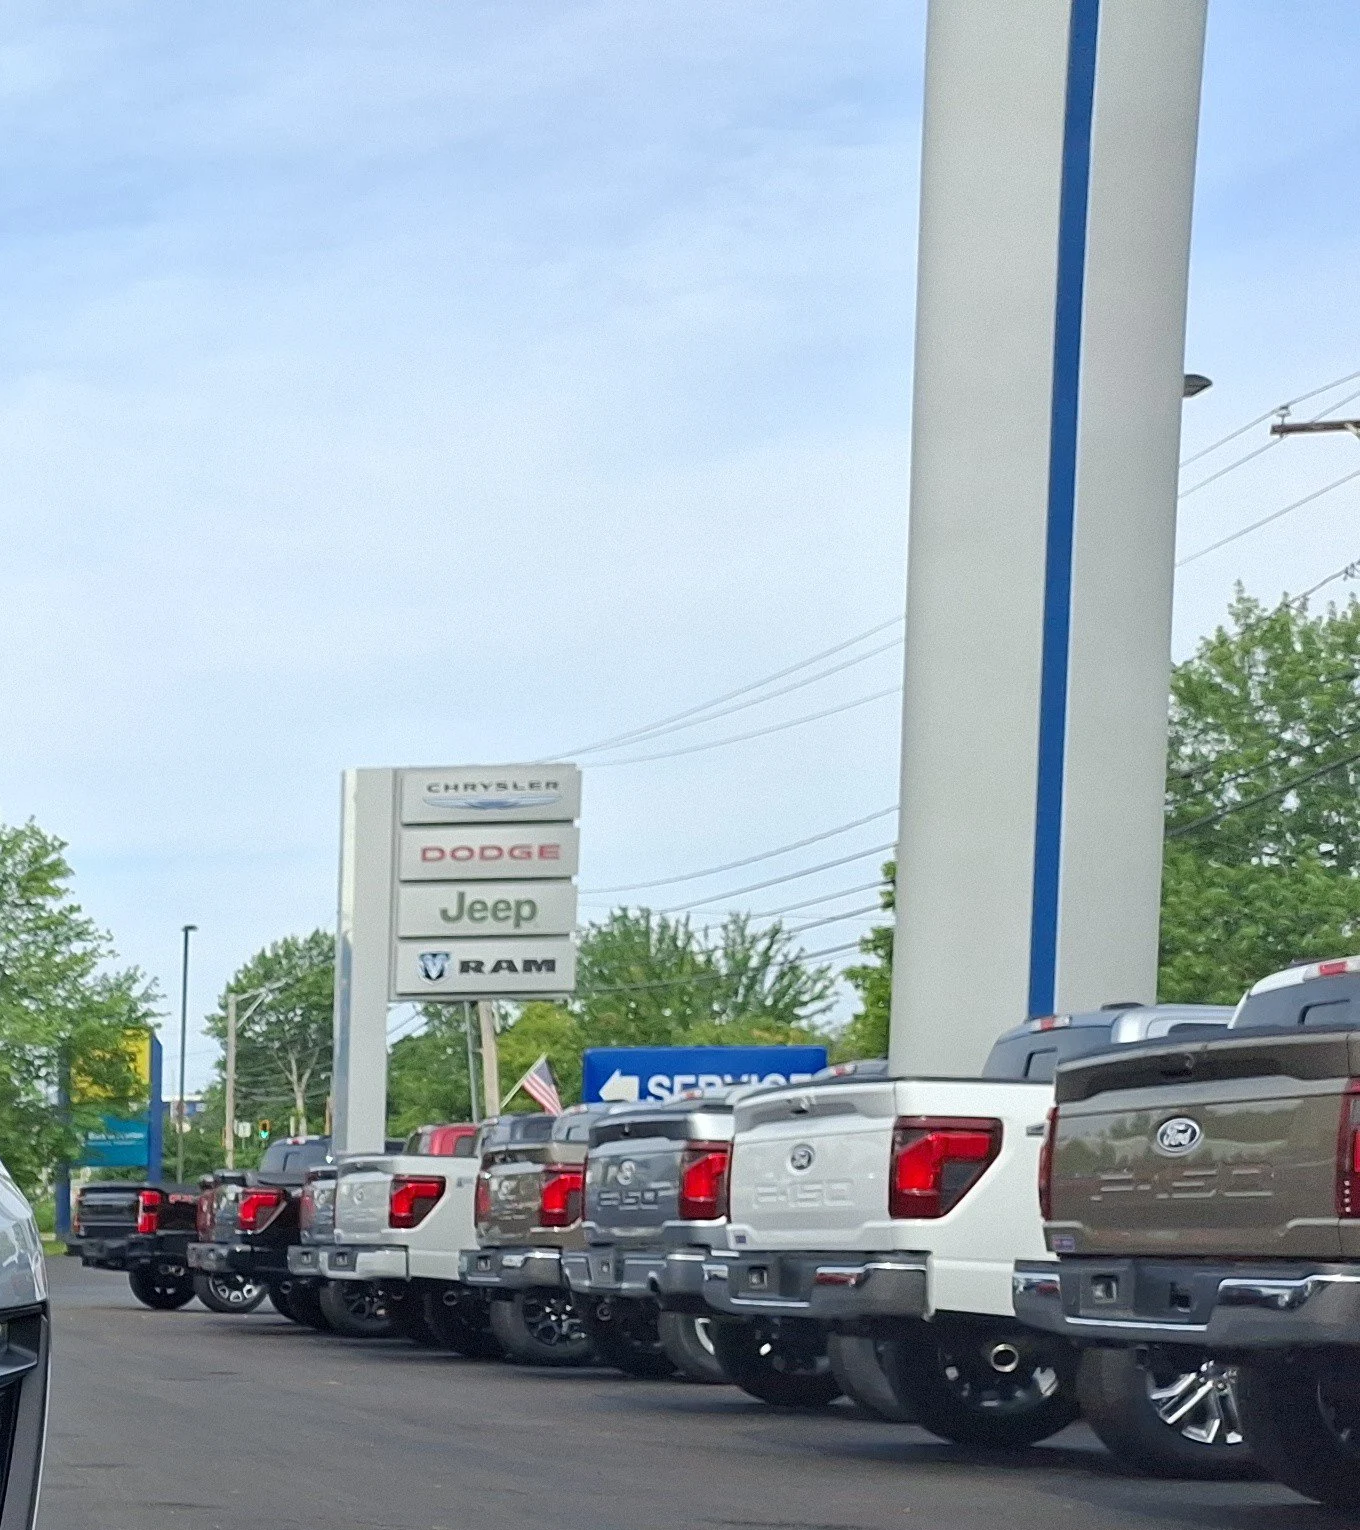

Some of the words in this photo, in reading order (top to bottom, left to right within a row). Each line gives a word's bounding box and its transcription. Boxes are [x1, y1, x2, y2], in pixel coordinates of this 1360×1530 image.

[426, 780, 560, 793] CHRYSLER
[421, 843, 561, 862] DODGE
[440, 891, 538, 928] Jeep
[459, 958, 556, 974] RAM
